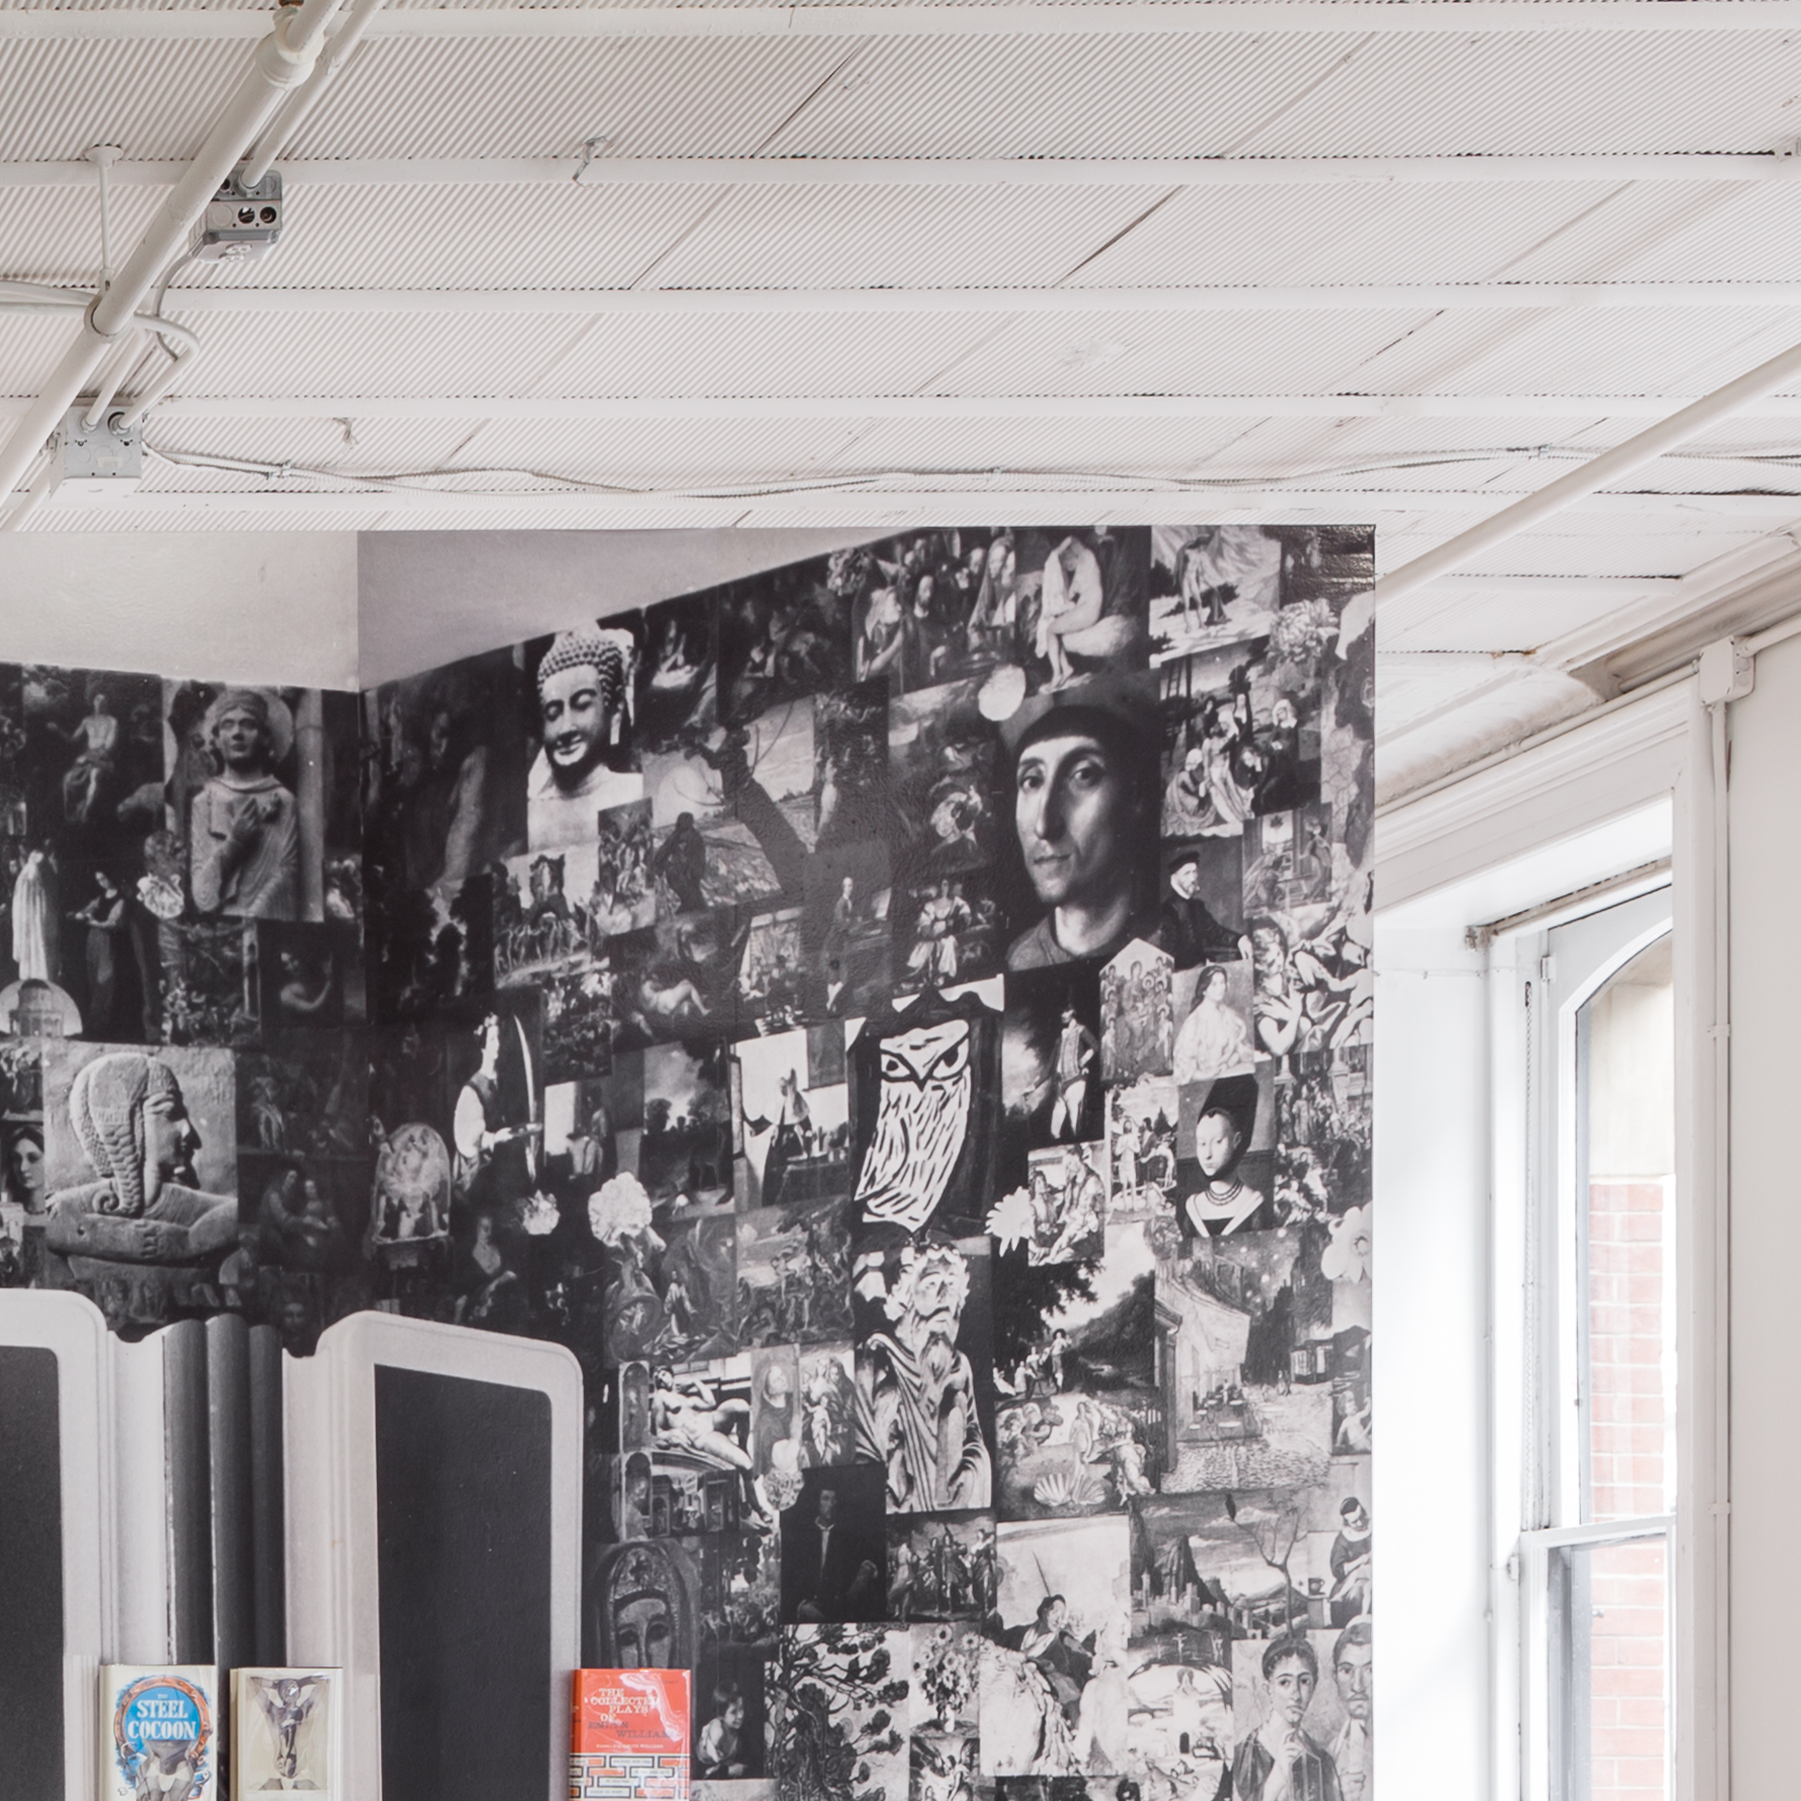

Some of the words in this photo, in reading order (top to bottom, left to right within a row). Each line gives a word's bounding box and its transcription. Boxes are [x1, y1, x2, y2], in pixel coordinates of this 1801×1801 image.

[599, 1688, 624, 1697] THE
[137, 1700, 188, 1718] STEEL
[609, 1705, 648, 1714] PLAYS
[127, 1721, 196, 1739] COCOON
